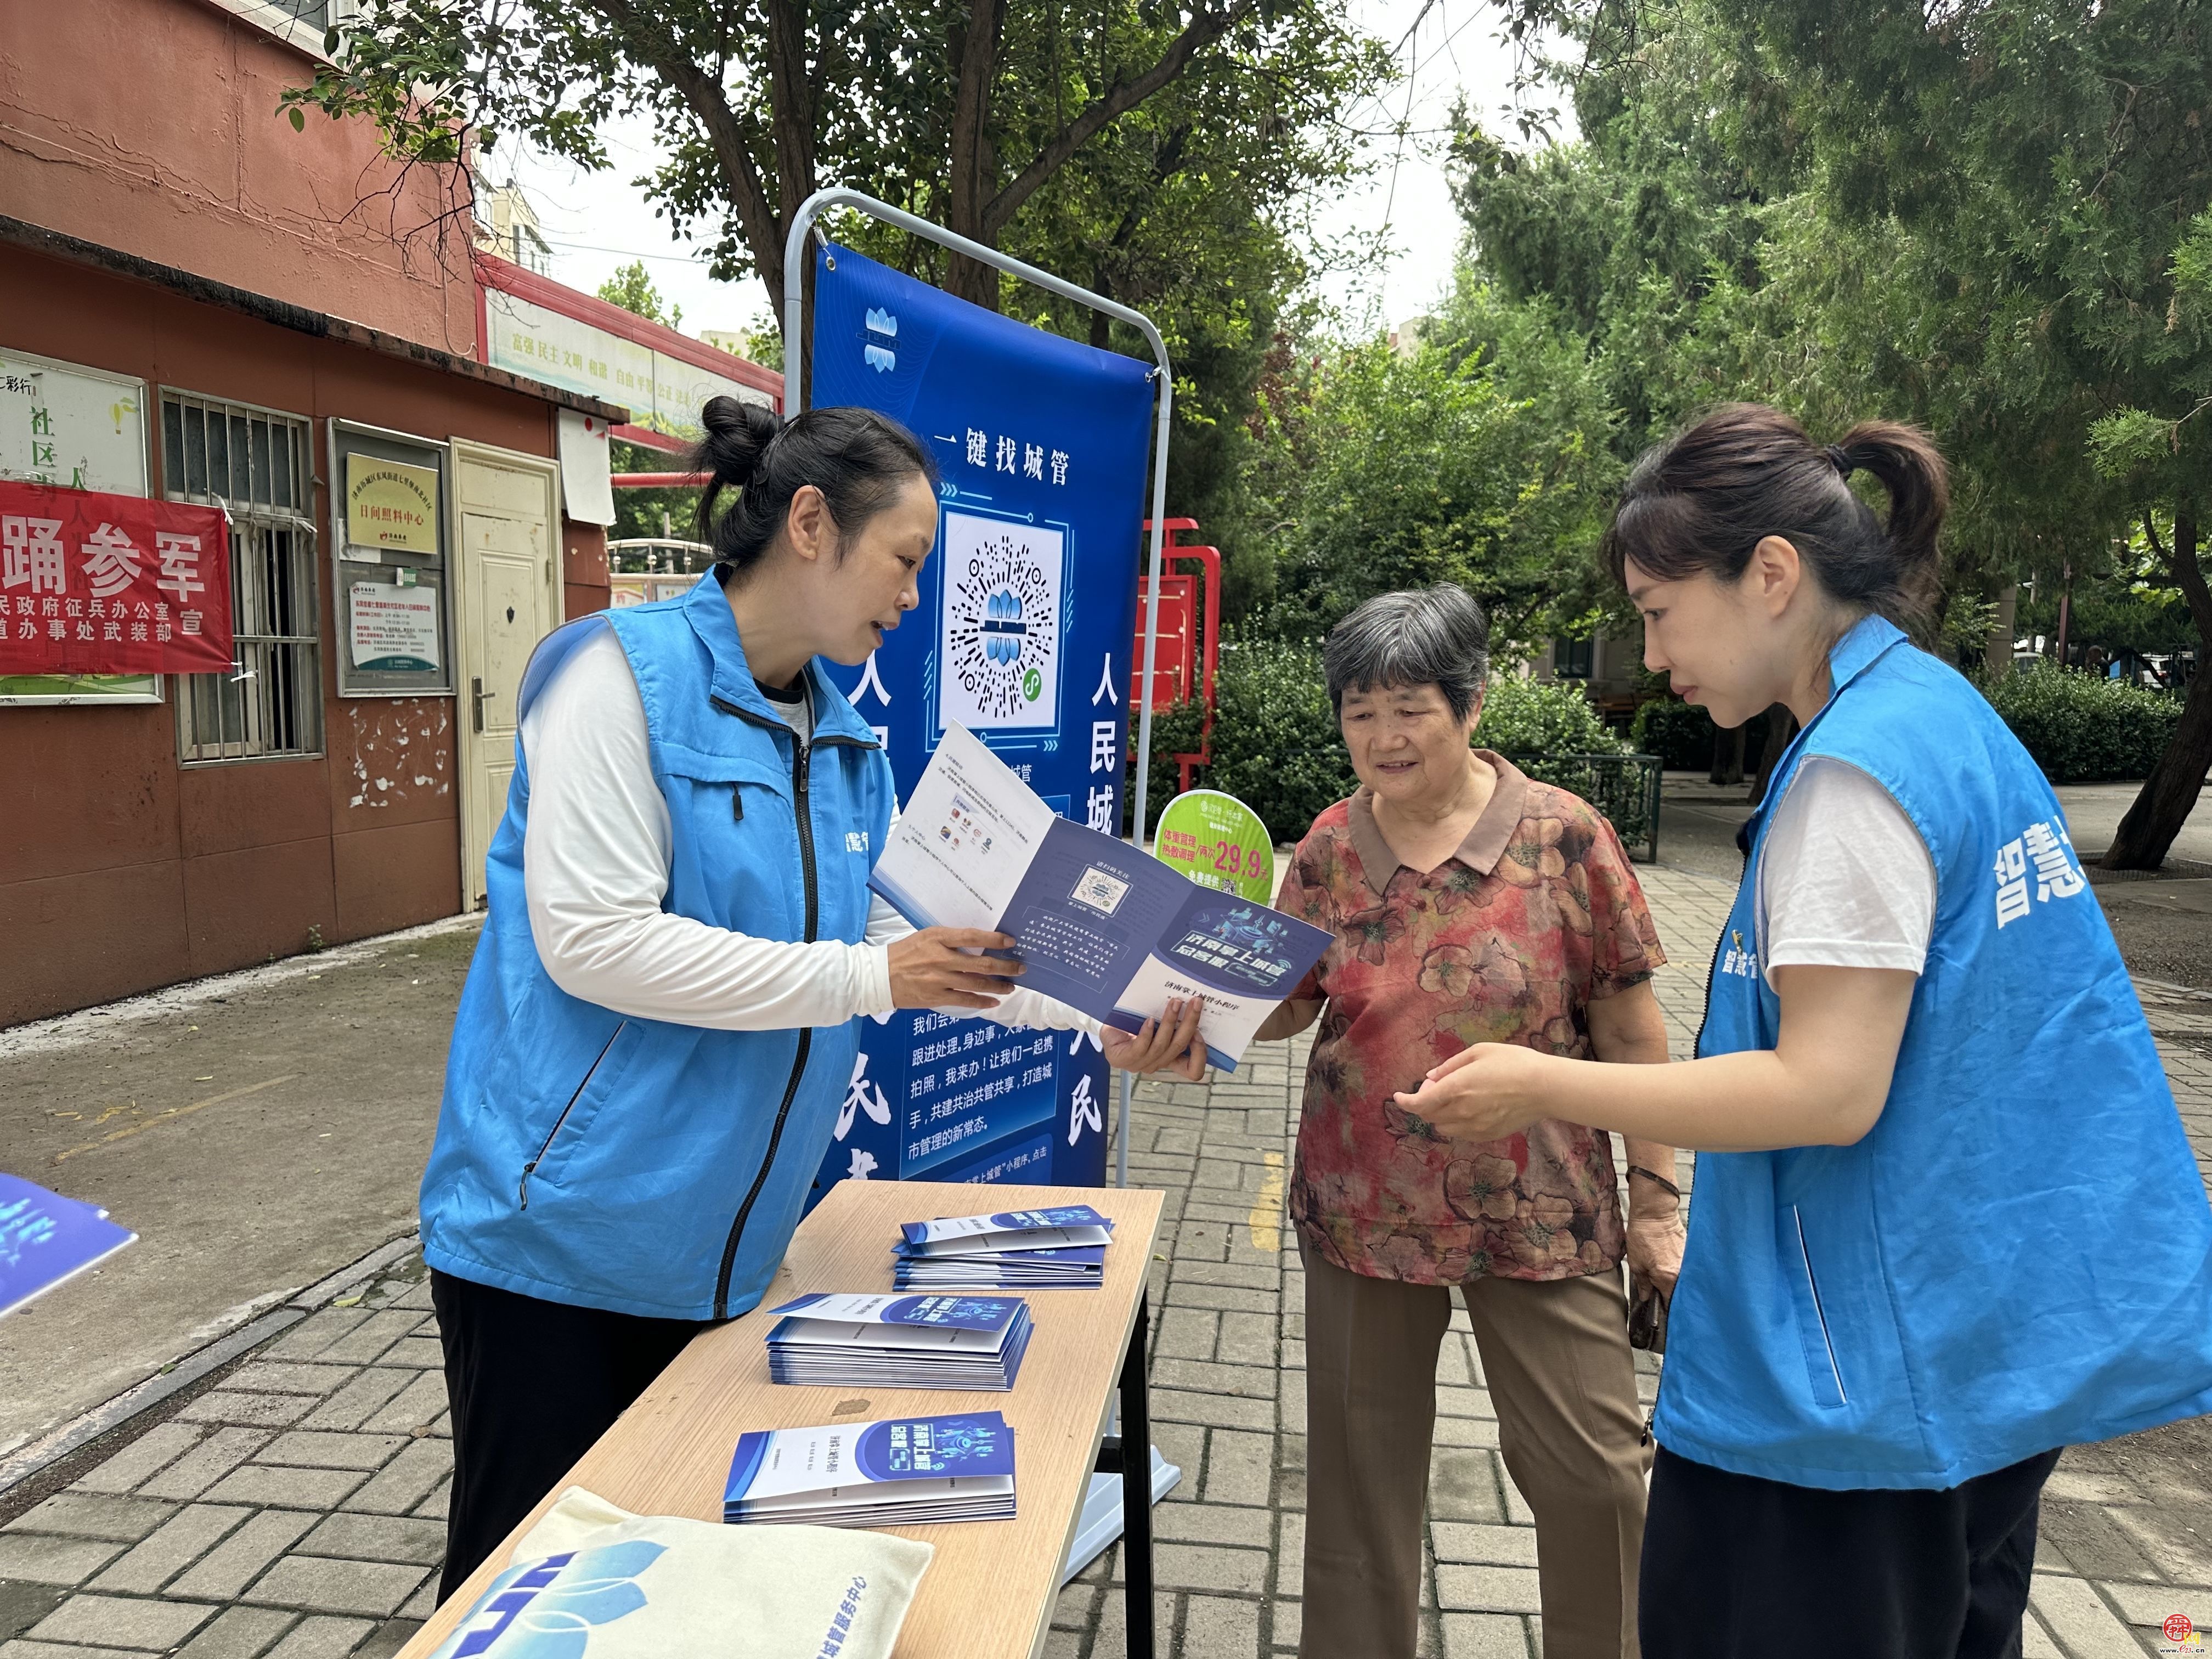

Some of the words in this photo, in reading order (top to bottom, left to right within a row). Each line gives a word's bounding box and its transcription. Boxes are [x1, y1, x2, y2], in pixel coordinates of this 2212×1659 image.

[512, 333, 534, 356] 富强
[538, 341, 558, 363] 民主
[563, 351, 582, 371] 文明
[588, 358, 607, 380] 和谐
[617, 368, 634, 389] 自由
[934, 427, 1069, 486] 一键找城管
[360, 504, 424, 526] 日间照料中心
[2, 514, 205, 602] 踊参军
[179, 609, 203, 636] 宣
[1085, 652, 1118, 836] 人民城
[1162, 844, 1195, 862] 热敷调理
[1164, 828, 1197, 847] 体重管理
[1214, 840, 1261, 878] 29.9
[1096, 861, 1130, 880] 请扫码关注
[1188, 870, 1219, 888] 免费提供
[1993, 815, 2086, 930] 智慧
[1177, 945, 1229, 968] 总客服
[1186, 933, 1287, 977] 济南掌上城管
[910, 1035, 1053, 1099] 拍照，我来办！让我们一起携
[912, 1022, 1034, 1067] 跟进处理。身边事，大家
[909, 1062, 1053, 1129] 手，共建共治共管共享，打造城
[908, 1115, 988, 1160] 市管理的新常态。
[891, 1426, 907, 1448] 总客服
[913, 1425, 935, 1470] 济南掌上城管
[816, 1576, 867, 1659] 城管服务中心
